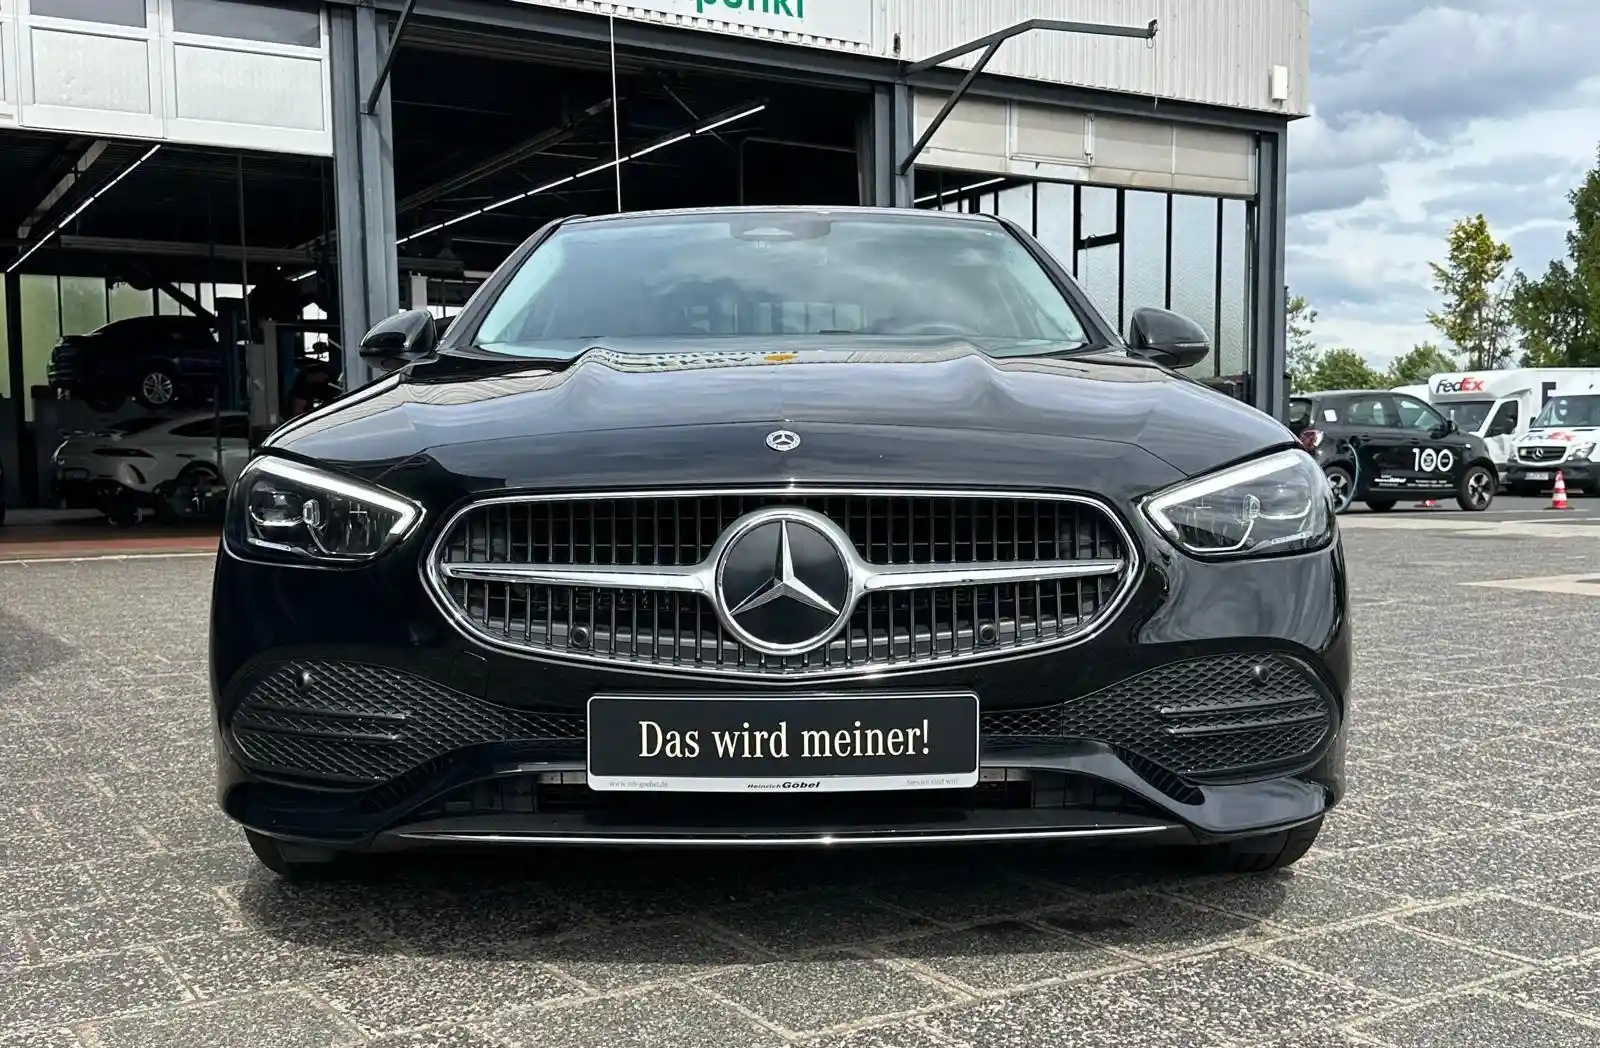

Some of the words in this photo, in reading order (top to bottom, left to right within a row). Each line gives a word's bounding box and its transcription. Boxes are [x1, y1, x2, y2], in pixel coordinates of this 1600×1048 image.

[1436, 377, 1485, 393] FedEx
[1412, 447, 1454, 472] 100
[638, 720, 700, 758] Das
[711, 721, 790, 758] wird
[800, 719, 930, 757] meiner!
